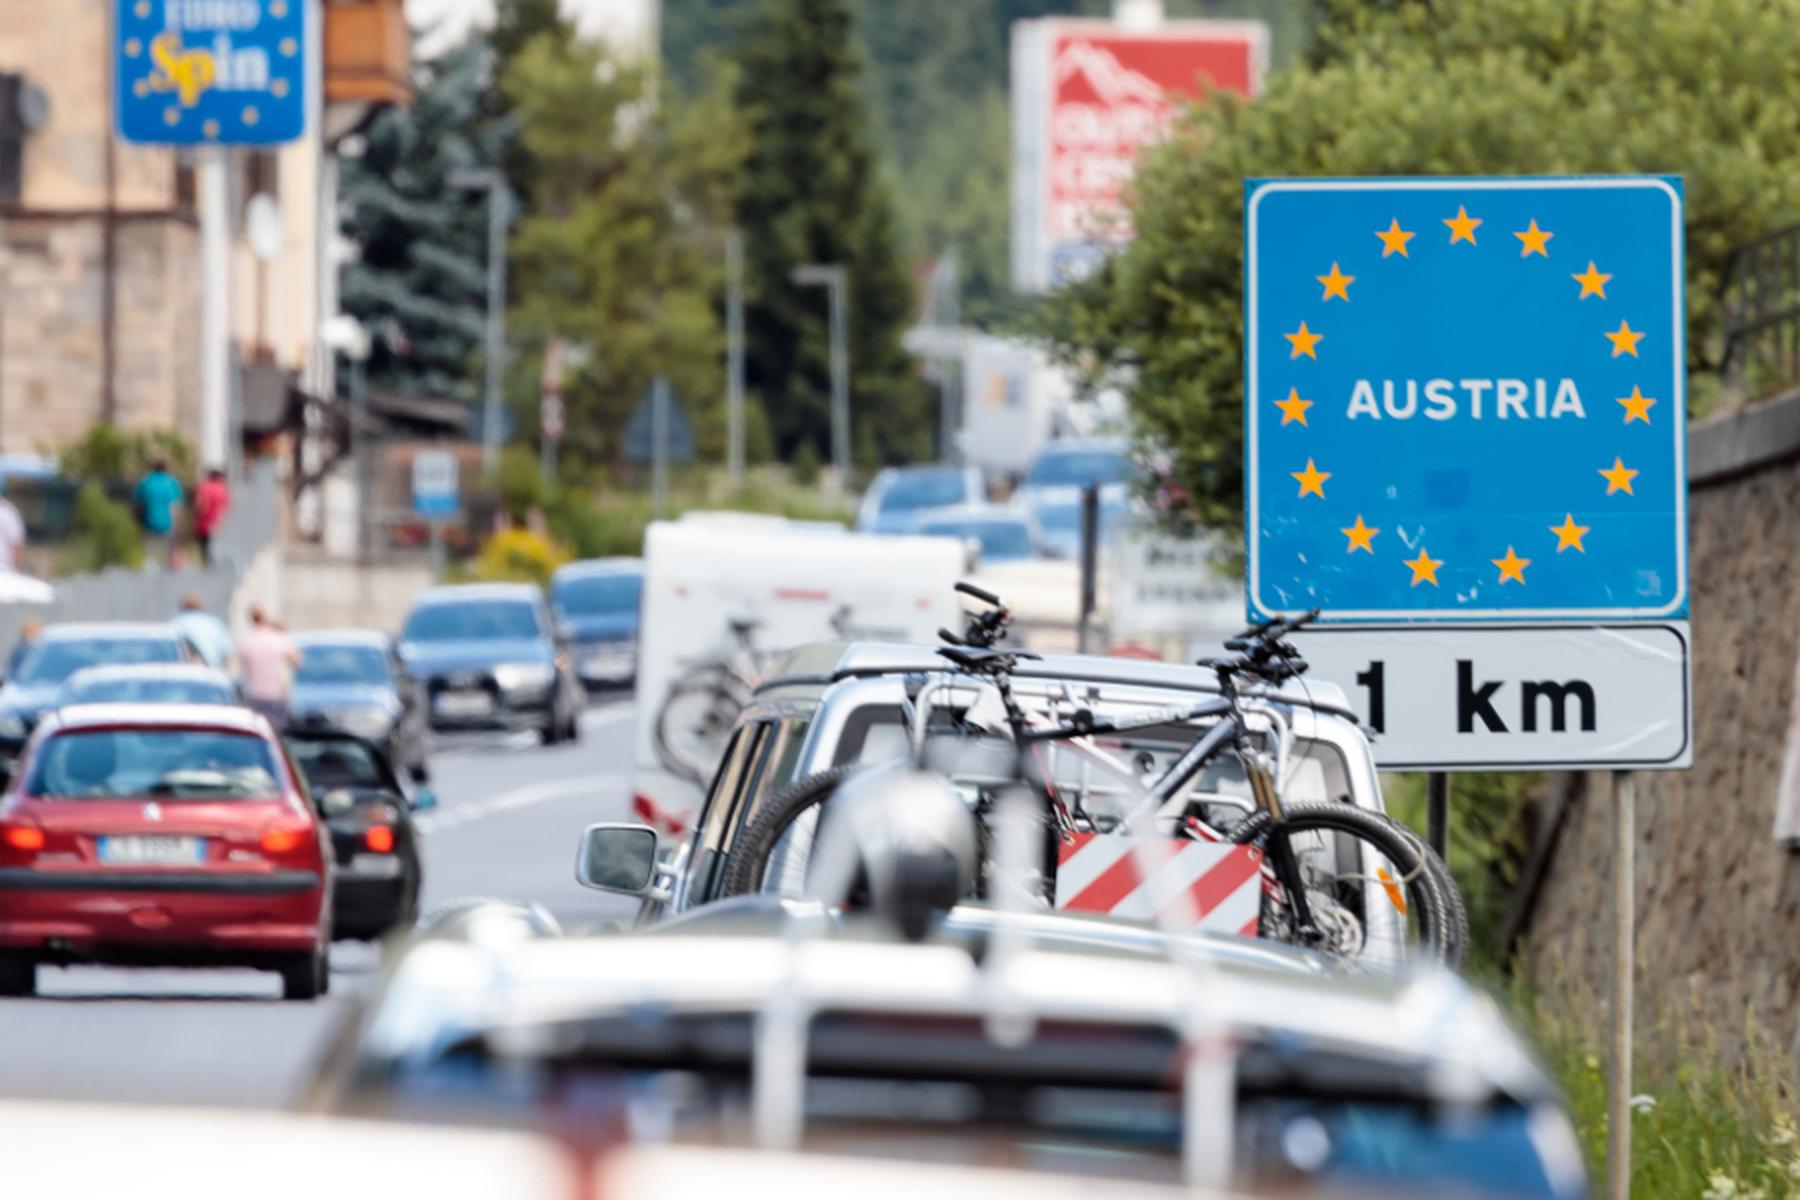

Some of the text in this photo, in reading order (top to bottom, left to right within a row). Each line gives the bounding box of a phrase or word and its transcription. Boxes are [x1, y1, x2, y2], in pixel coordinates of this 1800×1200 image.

[150, 30, 269, 108] Spin
[1346, 378, 1587, 421] AUSTRIA
[1356, 659, 1598, 733] 1 km
